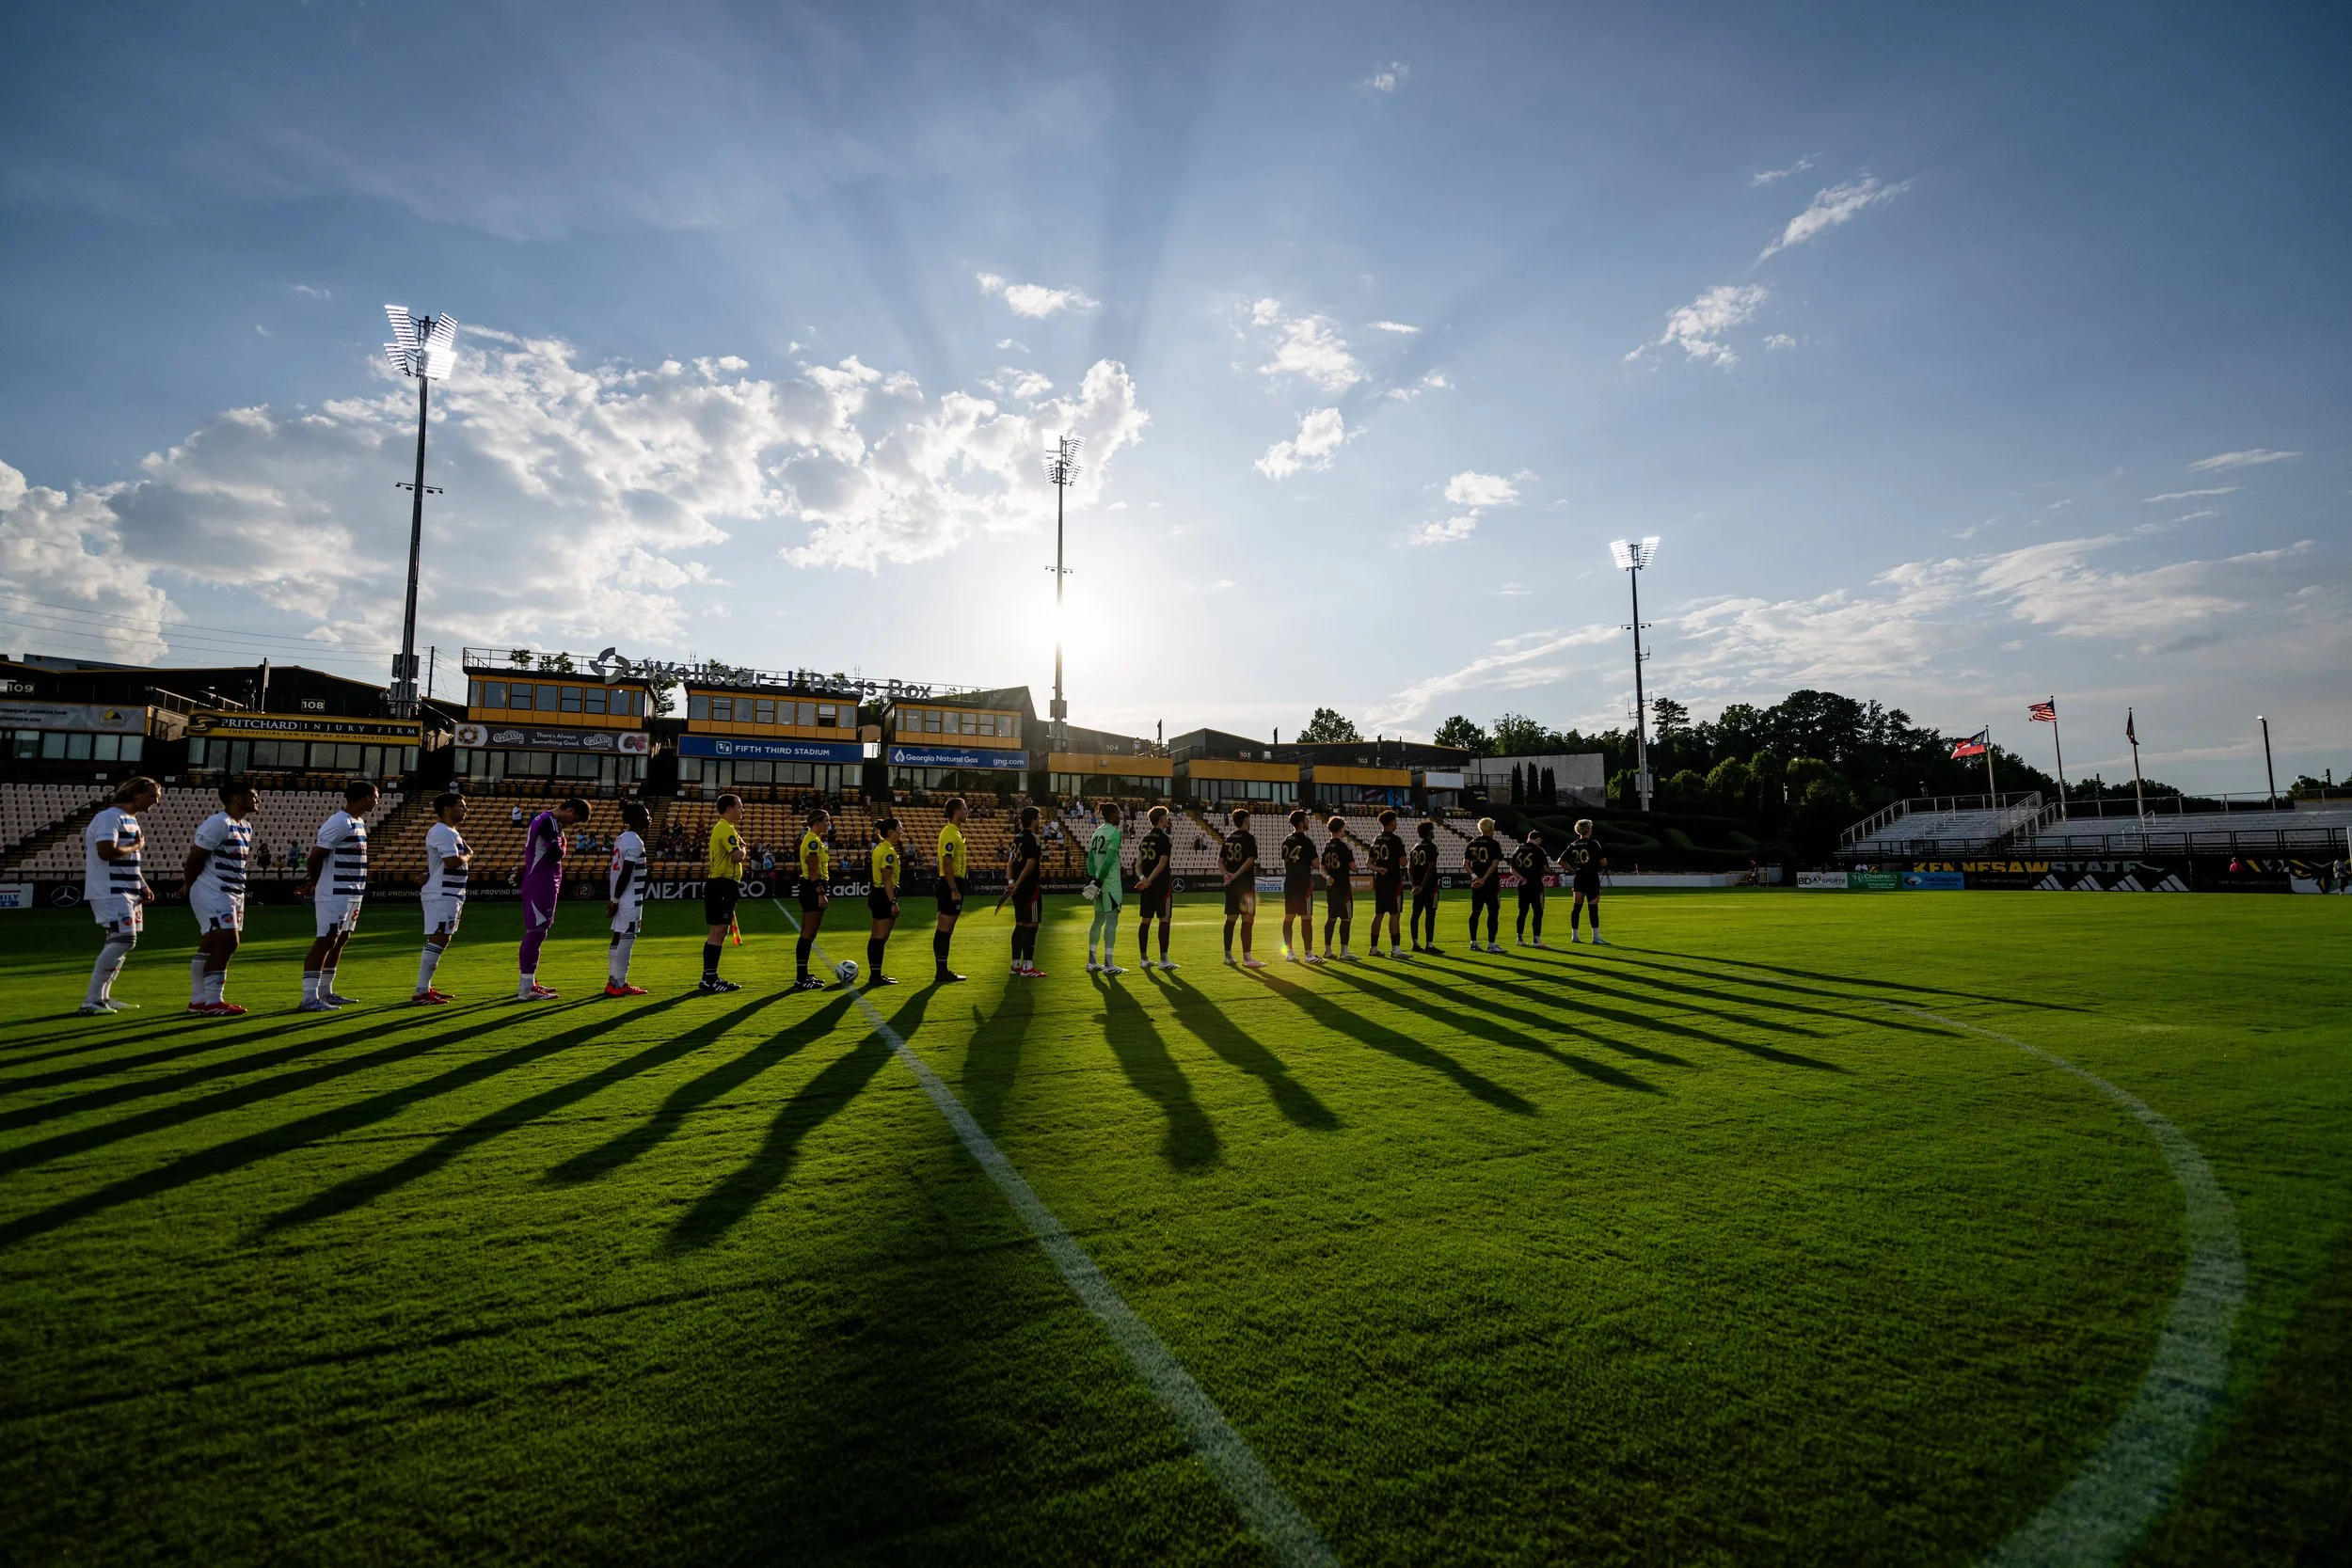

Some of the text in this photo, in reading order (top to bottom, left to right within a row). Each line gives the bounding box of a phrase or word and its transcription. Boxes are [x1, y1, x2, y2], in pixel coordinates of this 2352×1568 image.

[8, 683, 34, 692] 109
[643, 659, 931, 700] Wellstar Press Box
[302, 701, 325, 710] 108
[220, 718, 416, 735] PRITCHARD INJURY FIRM
[531, 738, 563, 747] Something
[764, 746, 792, 754] THIRD
[794, 748, 830, 756] STADIUM
[906, 753, 934, 763] Georgia
[1091, 835, 1107, 855] 42
[1140, 842, 1156, 861] 55
[1225, 842, 1243, 862] 38
[1324, 852, 1341, 869] 48
[1411, 849, 1426, 865] 80
[1469, 847, 1488, 863] 30
[1516, 852, 1534, 868] 66
[1571, 848, 1590, 864] 20
[832, 881, 872, 896] adid
